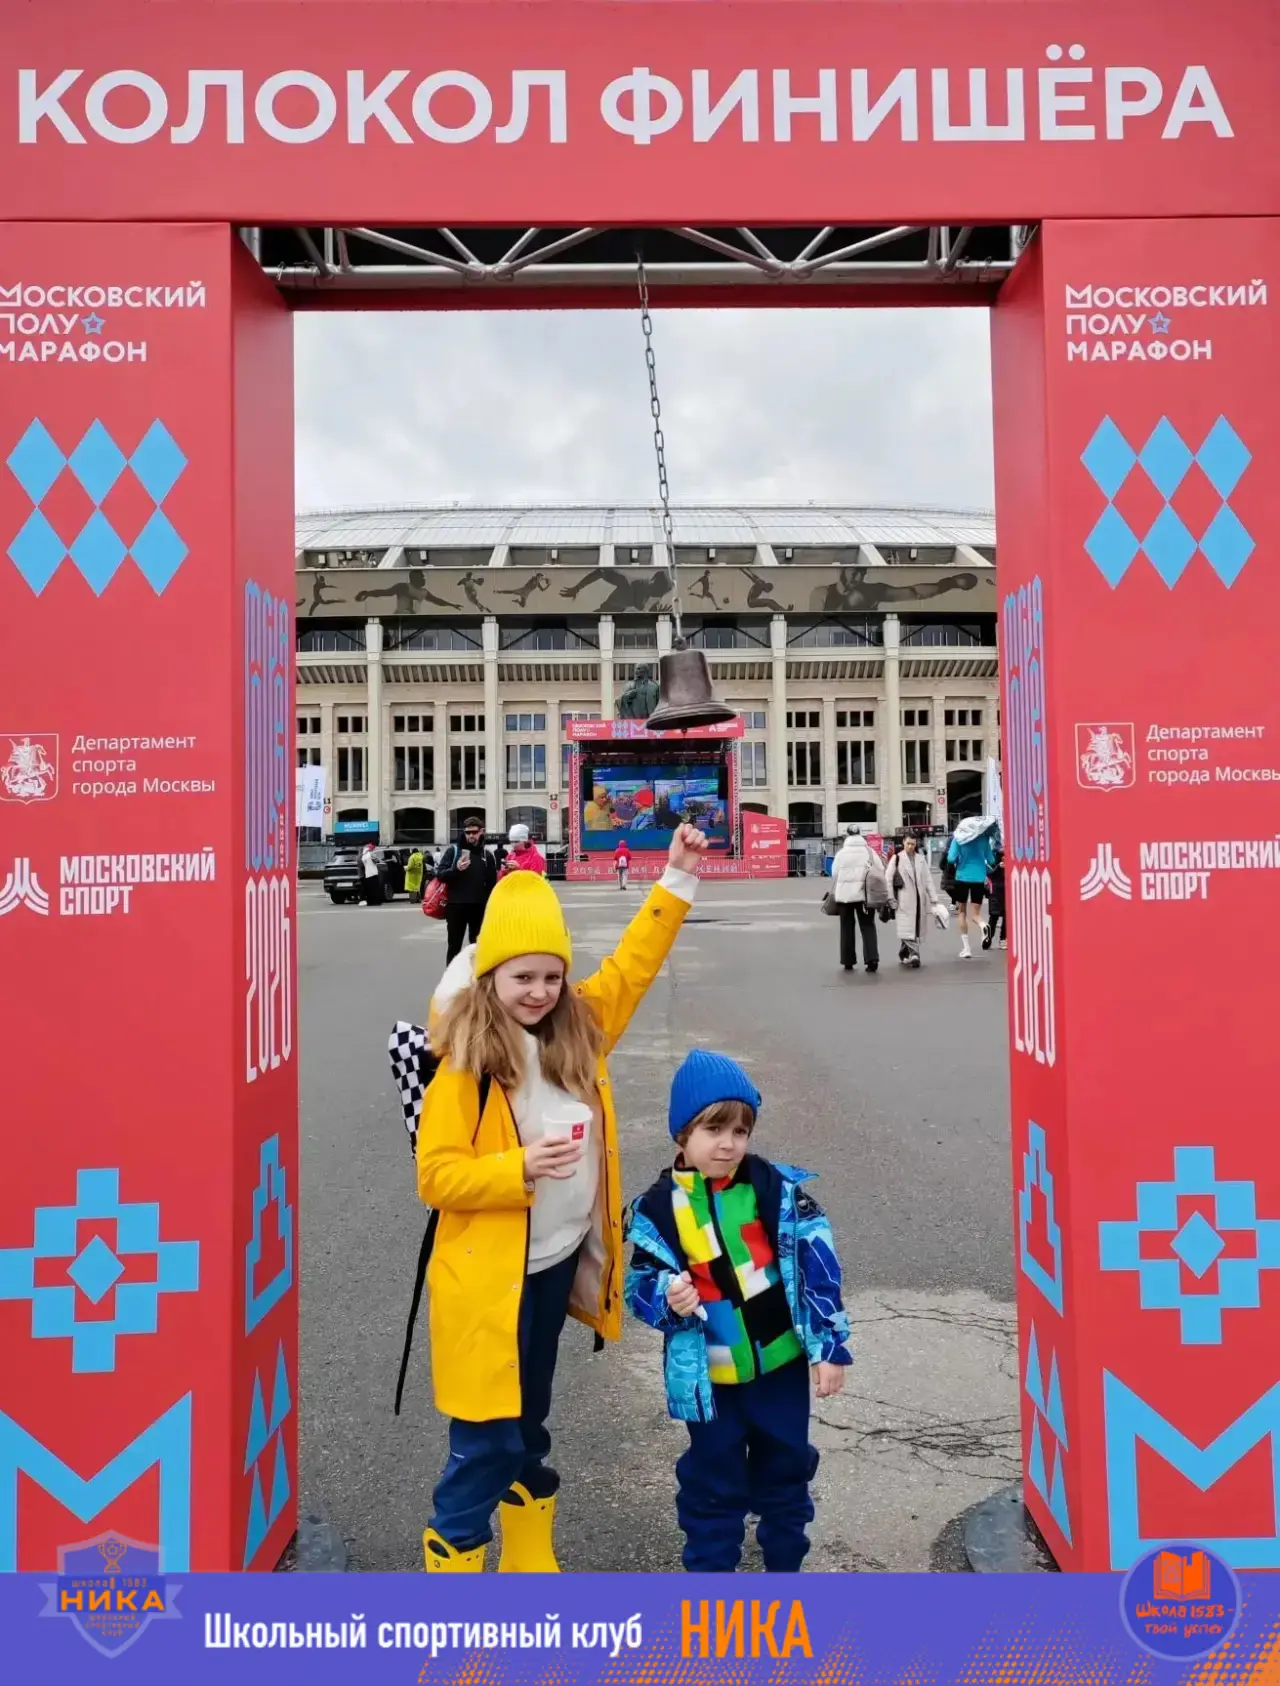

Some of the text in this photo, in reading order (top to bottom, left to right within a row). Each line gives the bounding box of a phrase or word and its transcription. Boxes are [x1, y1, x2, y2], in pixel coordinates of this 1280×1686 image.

[18, 44, 1235, 145] КОЛОКОЛ ФИНИШЁРА
[0, 280, 206, 308] МОСКОВСКИЙ
[1065, 279, 1267, 309] МОСКОВСКИЙ
[0, 313, 79, 335] ПОЛУ
[1066, 313, 1147, 335] ПОЛУ
[0, 341, 147, 362] МАРАФОН
[1067, 339, 1212, 361] МАРАФОН
[72, 735, 196, 753] Департамент
[1146, 724, 1265, 742] Департамент
[72, 759, 136, 775] спорта
[1147, 748, 1208, 764] спорта
[72, 778, 216, 798] города Москвы
[1148, 770, 1210, 787] города
[59, 847, 216, 884] МОСКОВСКИЙ
[1140, 872, 1210, 900] СПОРТ
[59, 885, 133, 916] СПОРТ
[1010, 865, 1055, 1068] 2026
[245, 874, 291, 1084] 2026
